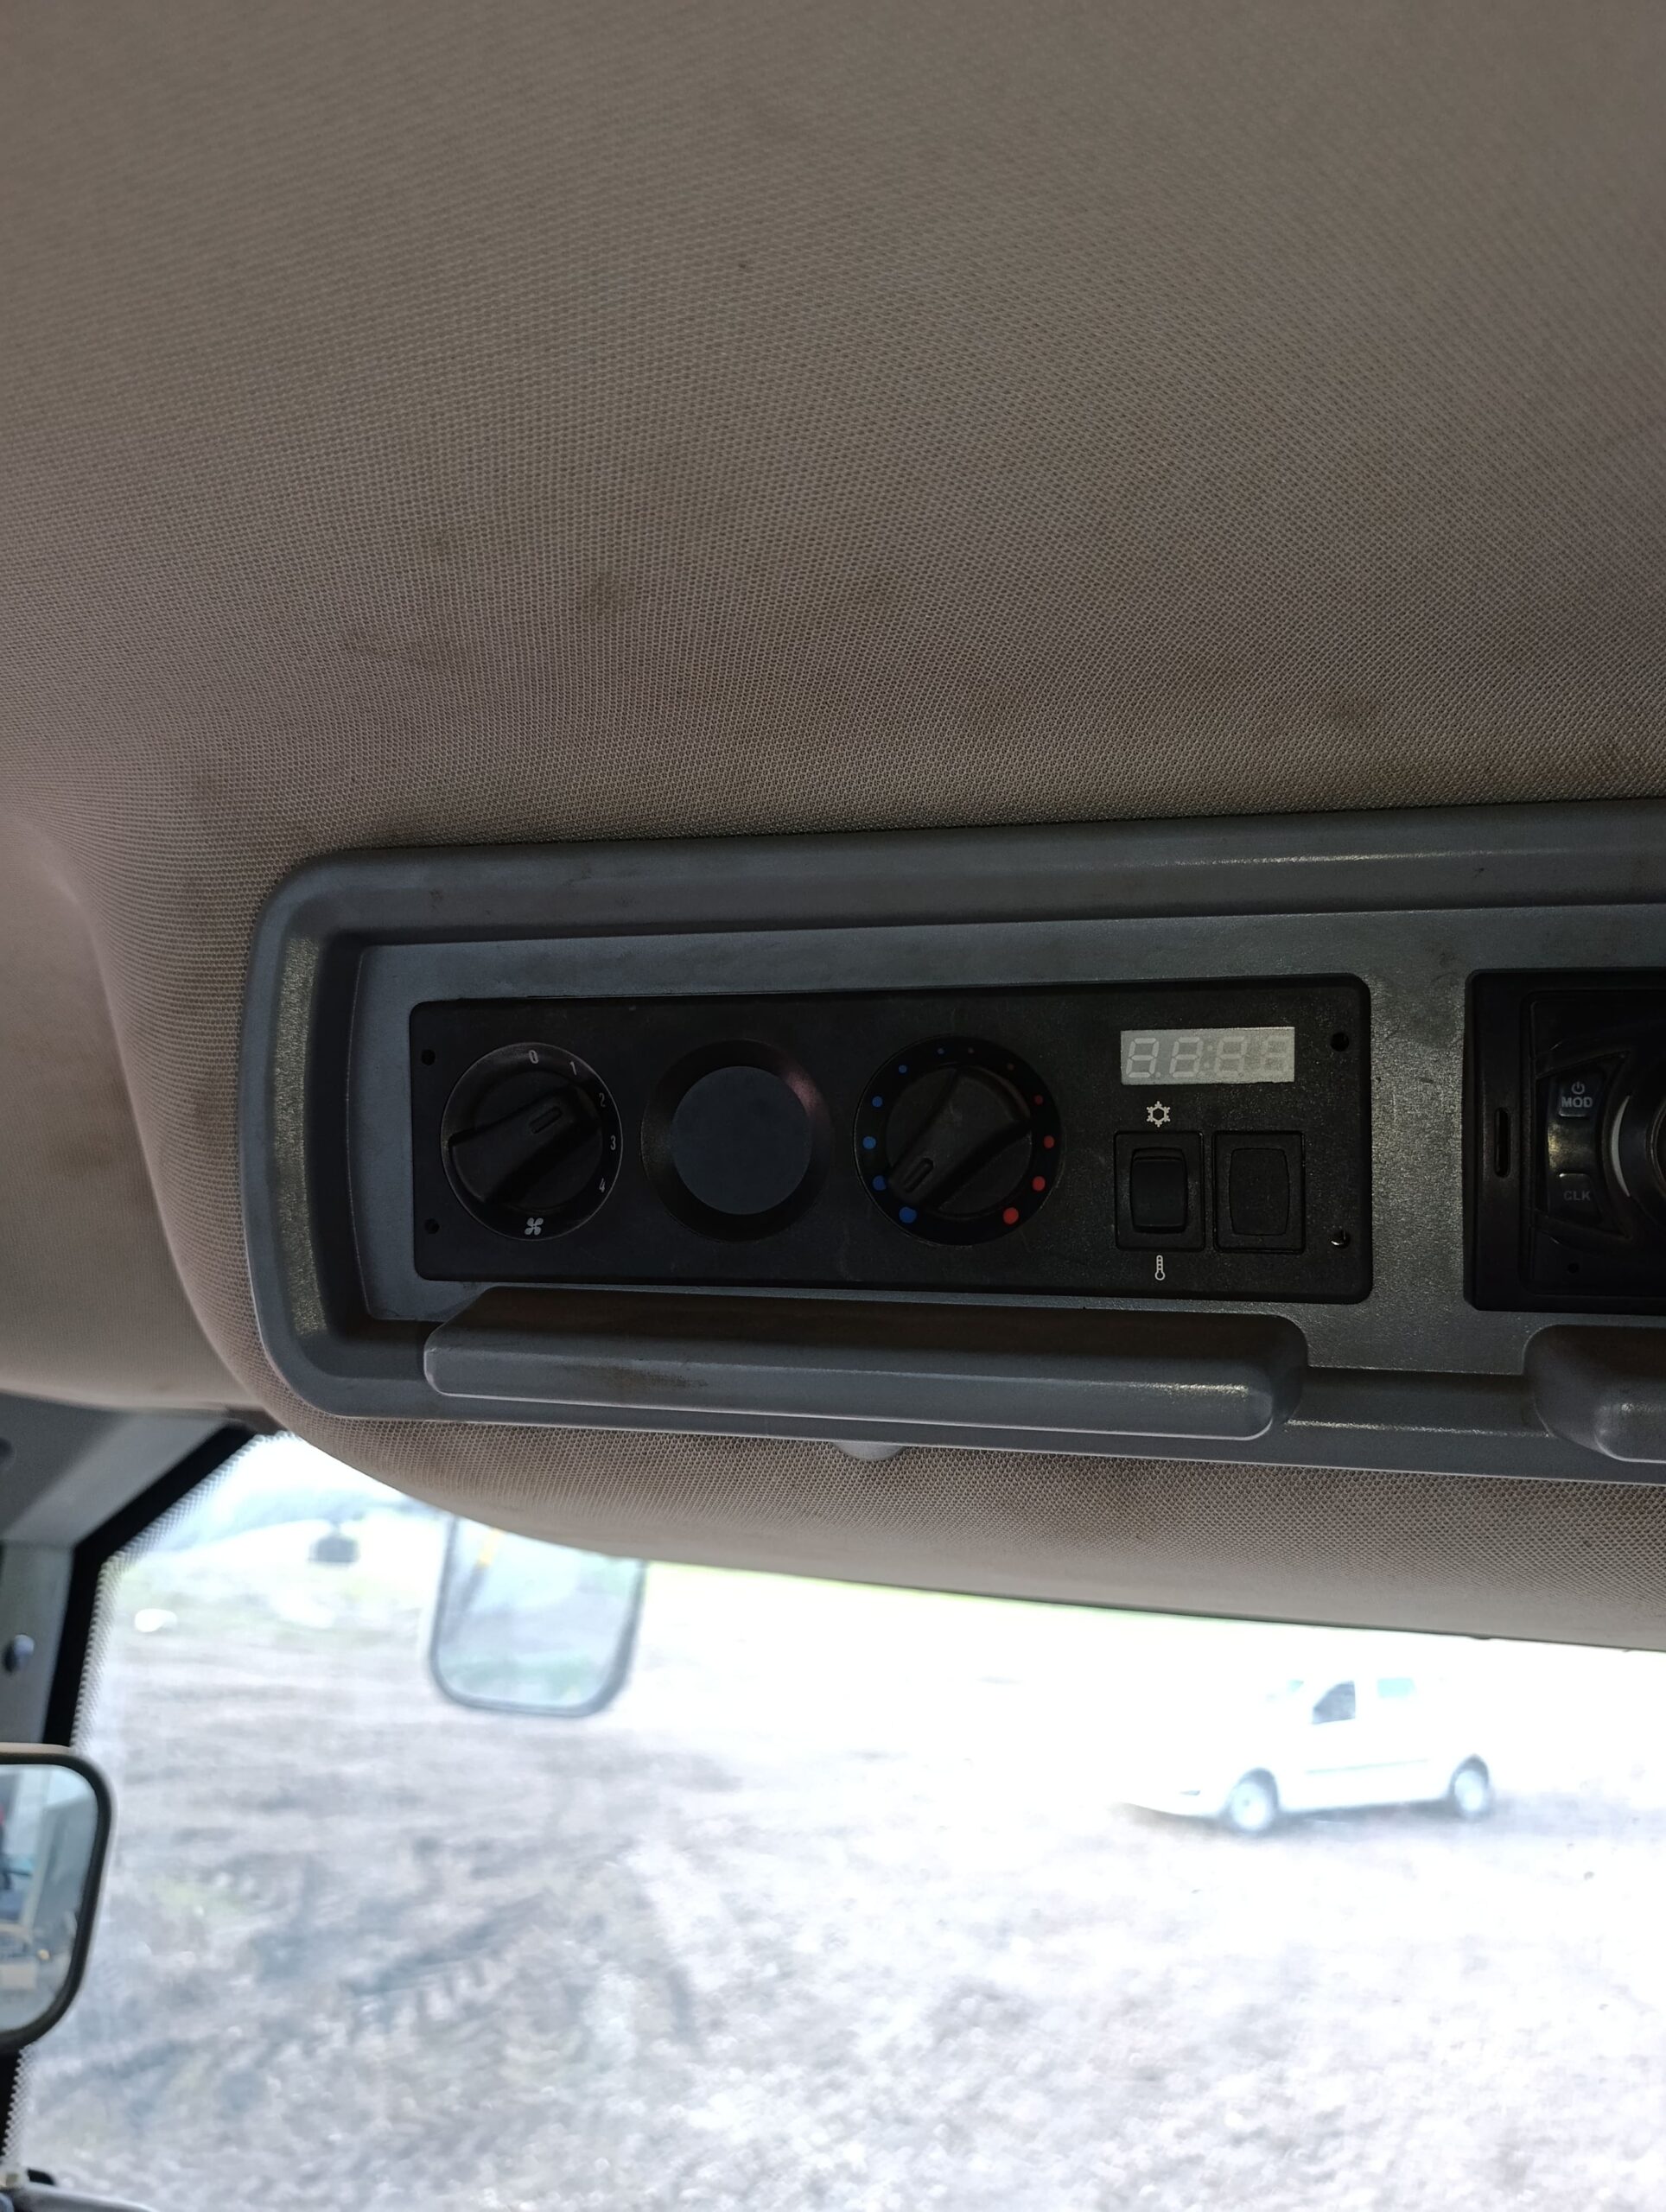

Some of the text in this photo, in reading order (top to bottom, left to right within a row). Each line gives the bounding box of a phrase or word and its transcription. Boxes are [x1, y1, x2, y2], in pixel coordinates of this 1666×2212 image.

[569, 1061, 578, 1076] 1
[598, 1092, 607, 1108] 2
[1561, 1096, 1593, 1109] MOD
[609, 1135, 617, 1151] 3
[598, 1177, 607, 1193] 4
[1563, 1190, 1592, 1202] CLK
